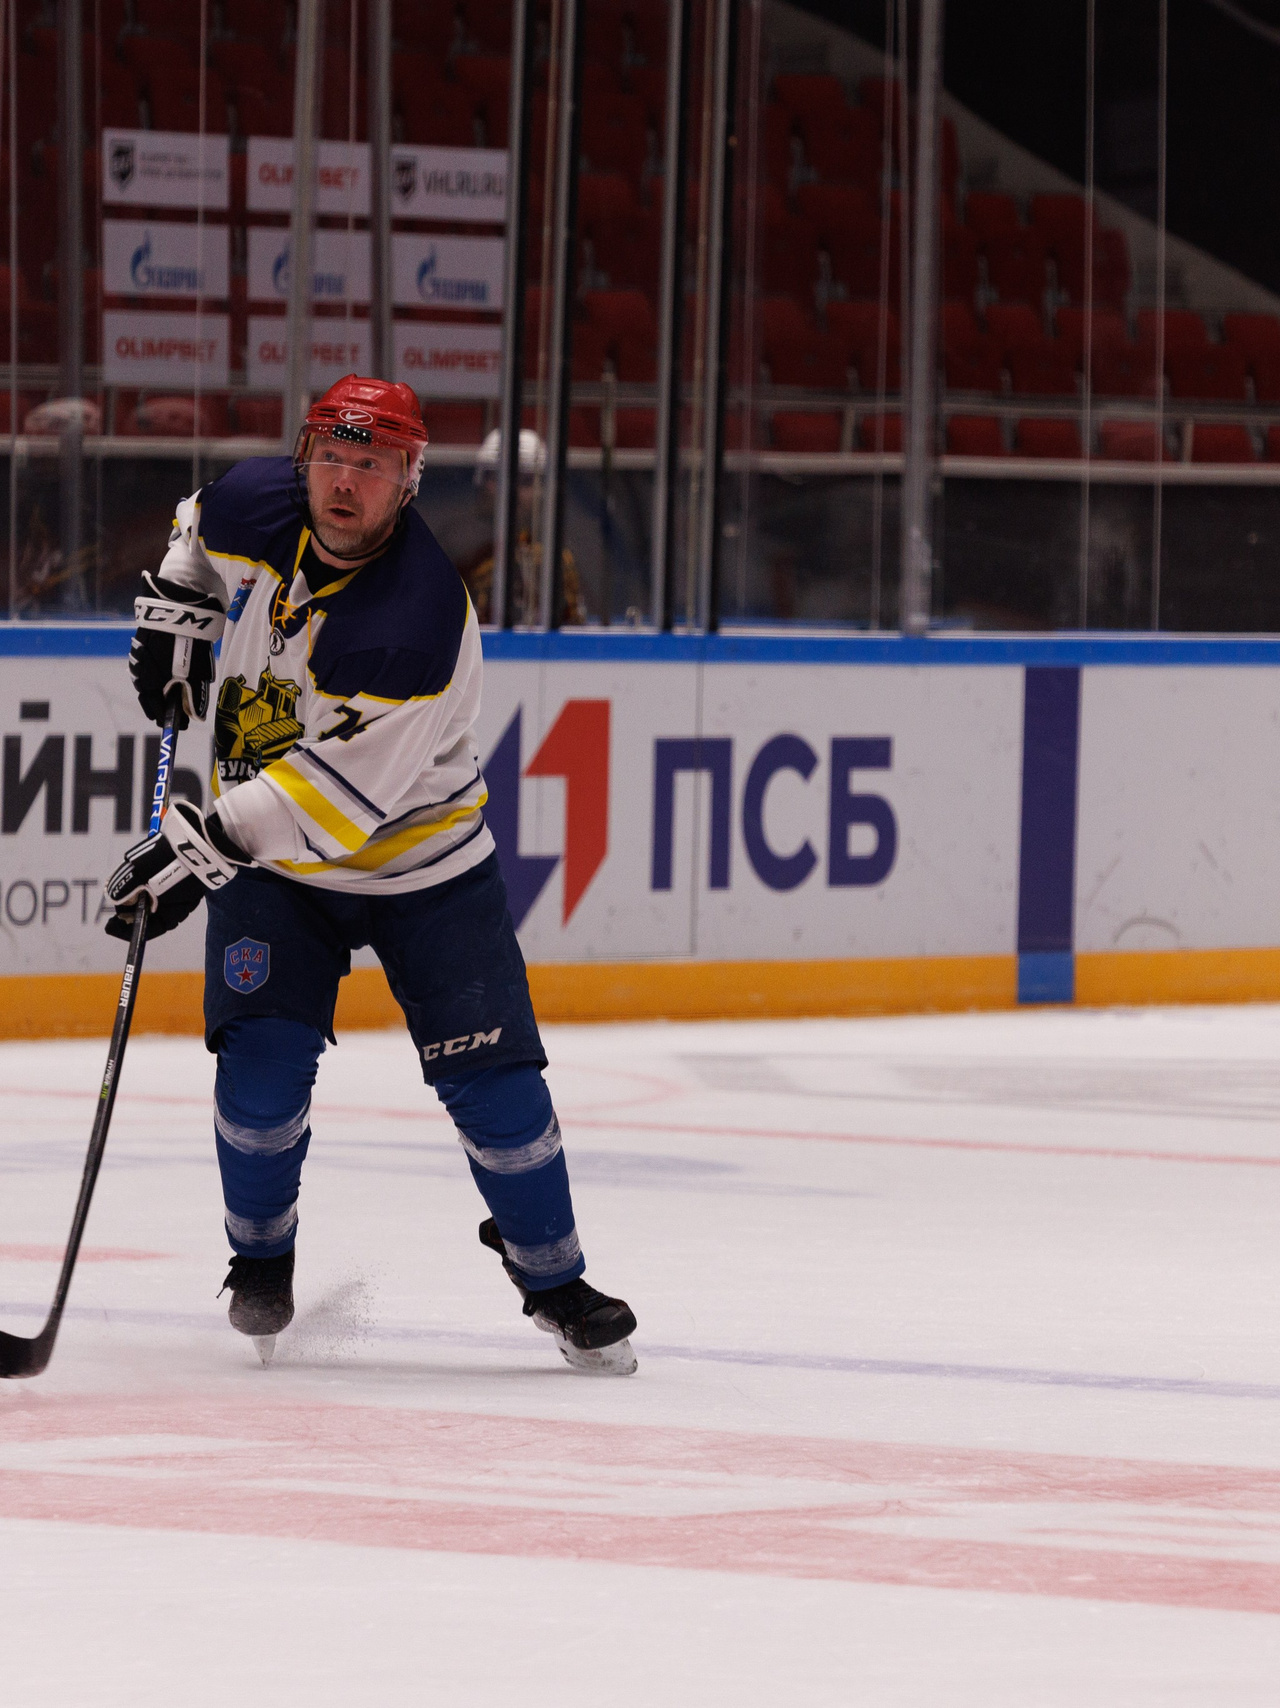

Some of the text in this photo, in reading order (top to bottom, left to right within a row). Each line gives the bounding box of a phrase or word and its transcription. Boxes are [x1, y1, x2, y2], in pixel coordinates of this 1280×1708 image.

[257, 163, 361, 190] OLIBET
[115, 335, 218, 363] OLIMPBET
[257, 340, 361, 367] OLBET
[402, 346, 501, 374] OLIMPBET
[151, 733, 173, 819] VAPOR
[218, 759, 264, 780] БУЛЬ
[649, 732, 900, 894] ПСБ
[229, 947, 264, 966] СКА
[422, 1026, 503, 1062] CCM
